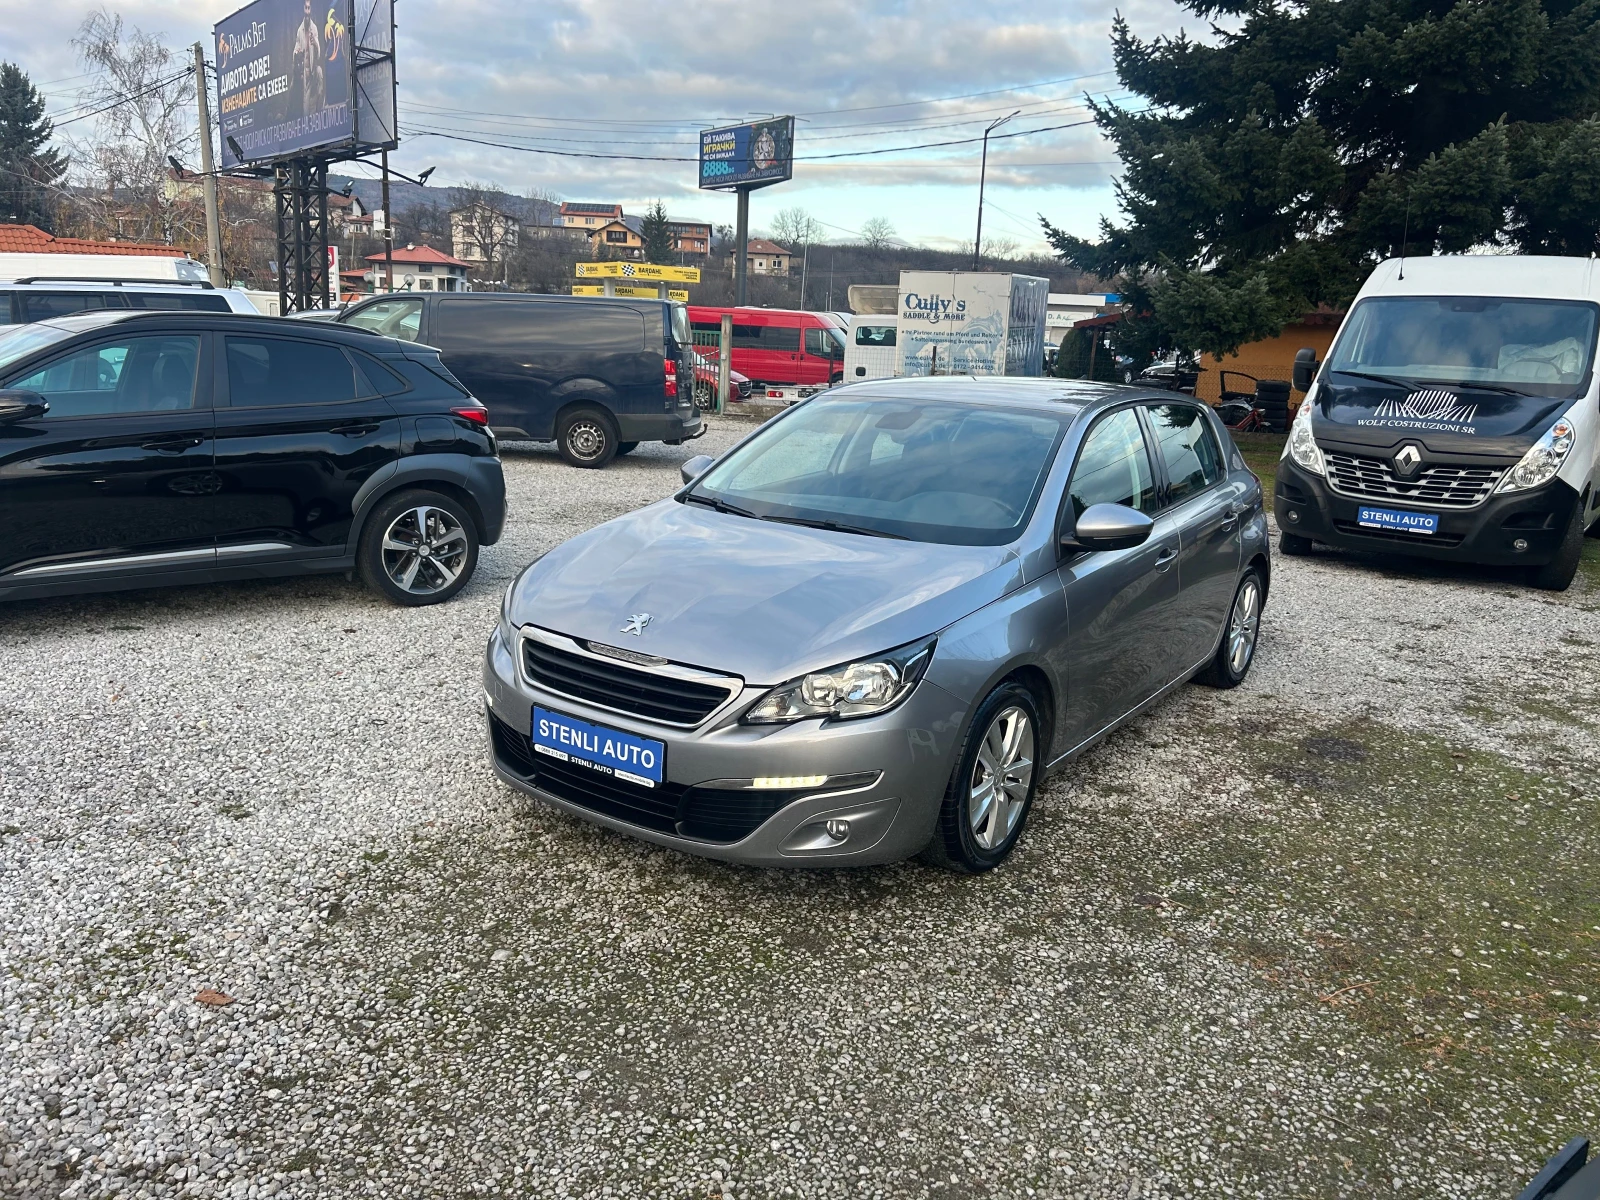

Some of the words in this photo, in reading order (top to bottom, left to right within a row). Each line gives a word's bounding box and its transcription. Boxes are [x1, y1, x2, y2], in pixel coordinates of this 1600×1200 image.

[252, 21, 267, 48] BET
[220, 65, 248, 96] ДИВОТО
[249, 54, 270, 82] ЗОВЕ!
[221, 86, 258, 115] ИЗНЕНАДИТЕ
[258, 82, 267, 100] СА
[267, 74, 288, 97] ЕХЕЕЕ!
[704, 134, 711, 144] ЕЙ
[712, 132, 735, 142] ТАКИВА
[704, 140, 735, 154] ИГРАЧКИ
[638, 267, 662, 276] BARDAHL
[615, 288, 635, 297] ARDAHL
[669, 291, 686, 299] RDAHL
[905, 293, 966, 313] Cully's
[903, 312, 931, 320] SADDLE
[933, 312, 940, 320] &
[944, 313, 966, 321] MORE
[1357, 418, 1386, 427] WOLF
[1387, 420, 1460, 432] COSTRUZIONI
[1361, 510, 1400, 523] STENLI
[1402, 516, 1434, 527] AUTO
[539, 719, 598, 753] STENLI
[603, 739, 655, 769] AUTO
[570, 756, 592, 768] STENLI
[593, 762, 613, 775] AUTO
